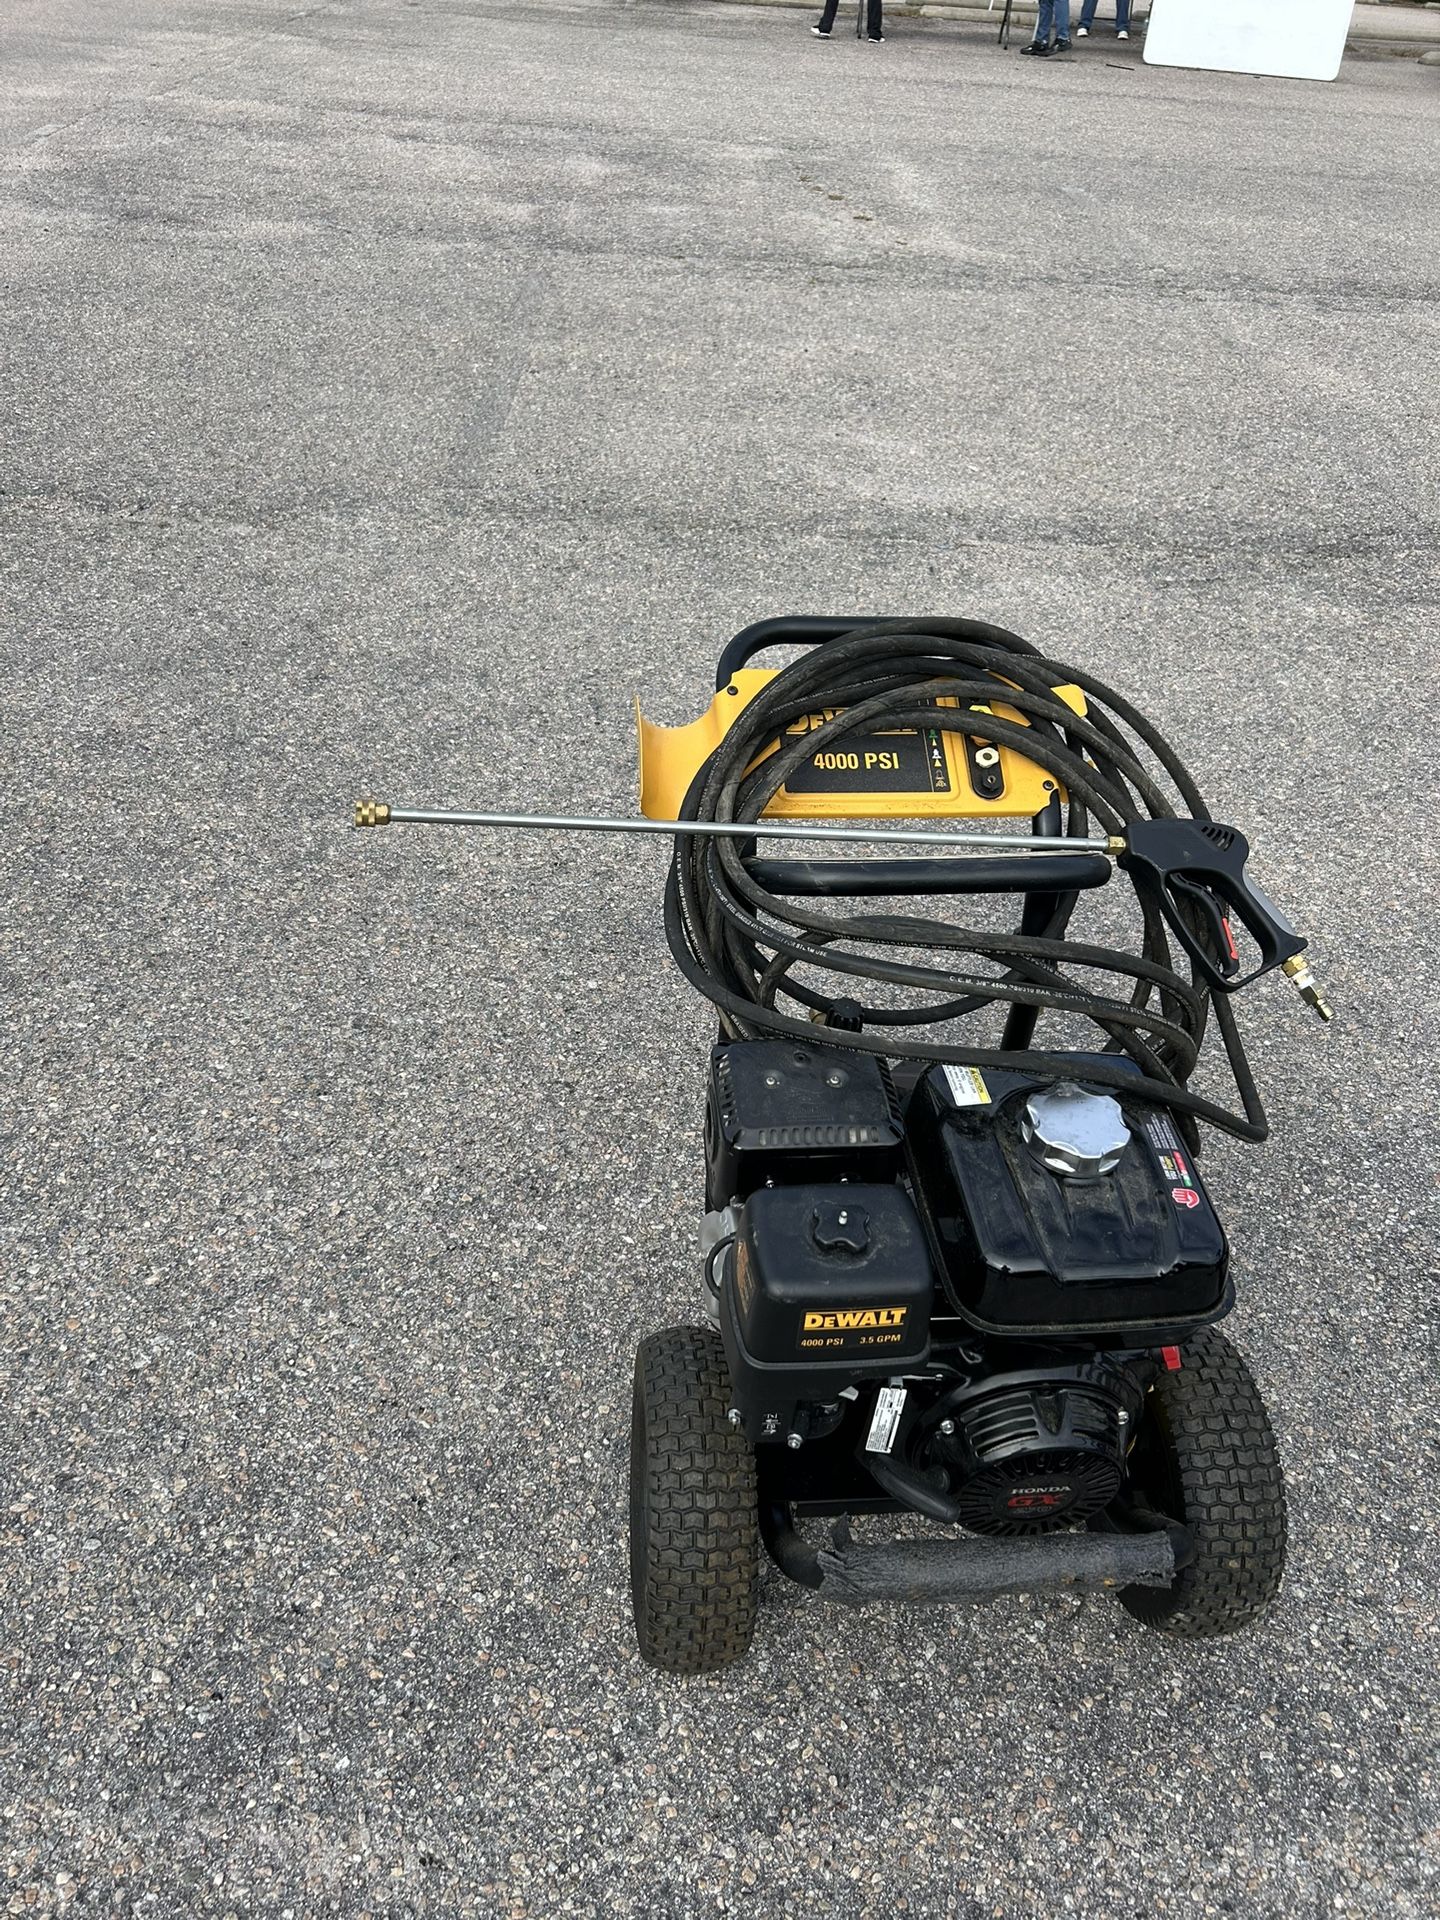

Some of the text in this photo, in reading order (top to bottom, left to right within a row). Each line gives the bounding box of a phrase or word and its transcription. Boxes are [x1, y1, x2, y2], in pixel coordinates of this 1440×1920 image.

[813, 752, 900, 770] 4000 PSI
[801, 1334, 901, 1347] 4000 PSI 3.5 GPM
[1010, 1485, 1072, 1495] HONDA
